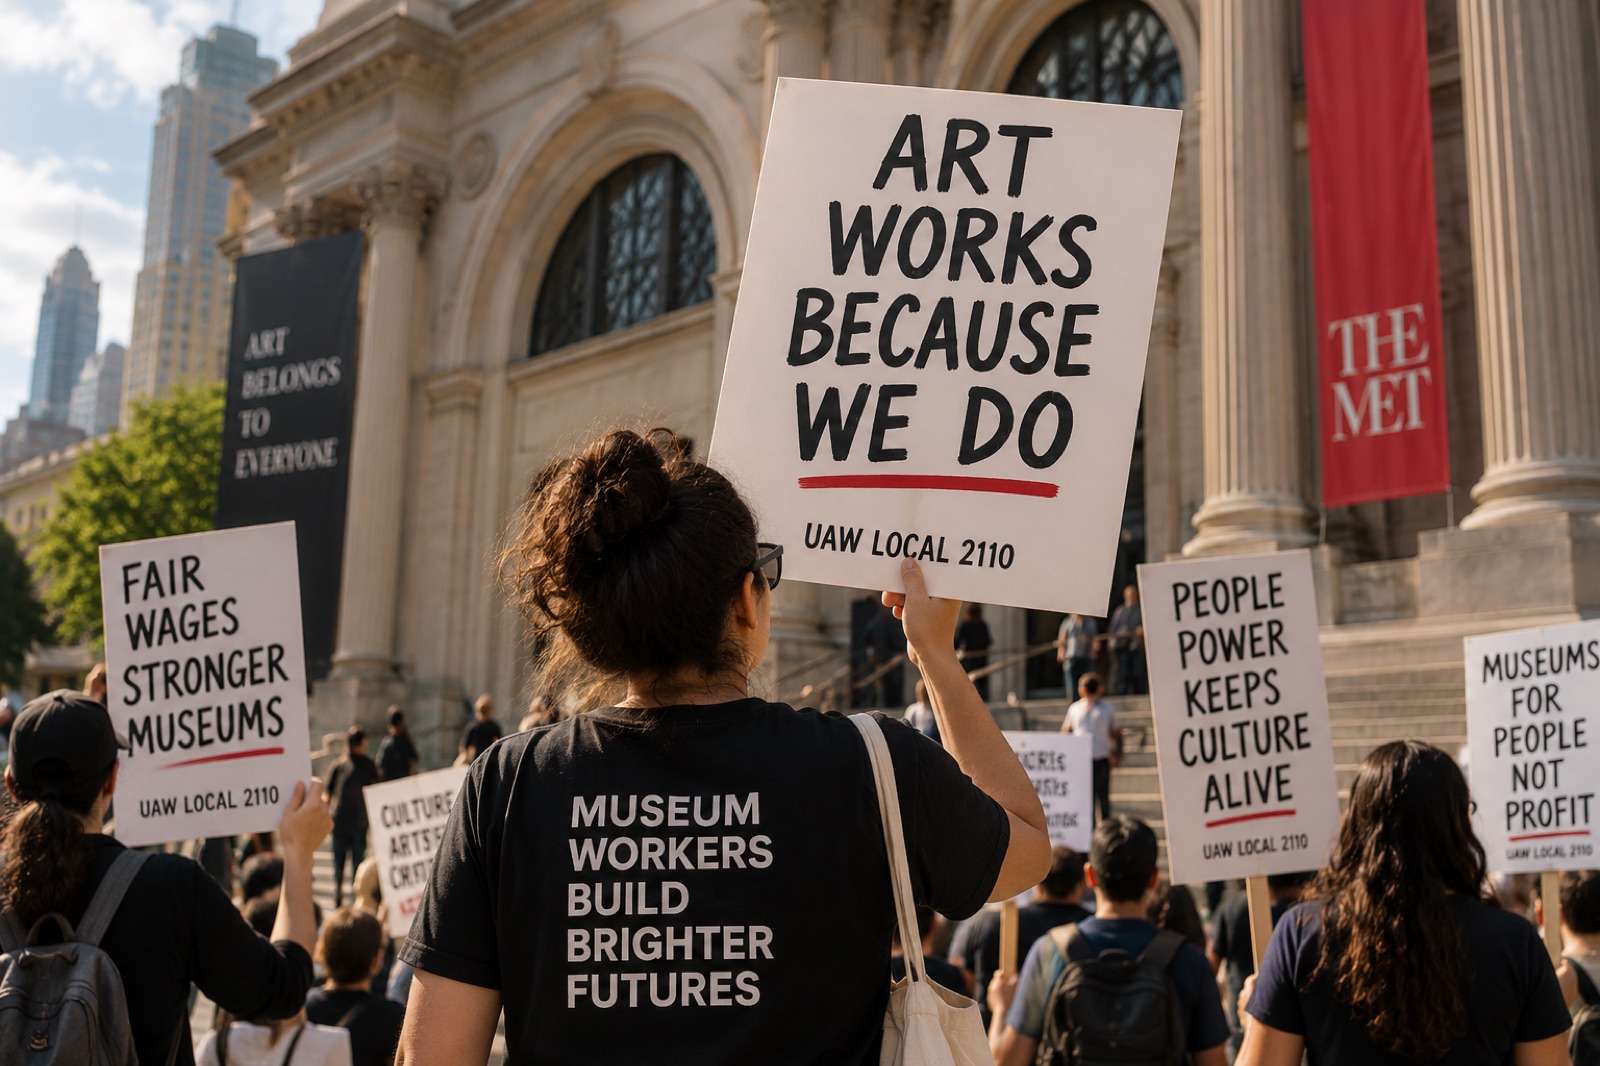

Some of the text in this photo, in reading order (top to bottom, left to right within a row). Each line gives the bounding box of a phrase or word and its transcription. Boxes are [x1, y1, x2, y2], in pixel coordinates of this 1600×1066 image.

[872, 114, 1053, 198] ART
[829, 201, 1097, 289] WORKS
[244, 326, 290, 361] ART
[786, 287, 1099, 377] BECAUSE
[1328, 303, 1430, 377] THE
[242, 355, 342, 399] BELONGS
[238, 407, 271, 438] TO
[796, 382, 1074, 469] WE DO
[1331, 366, 1432, 442] MET
[235, 437, 339, 478] EVERYONE
[804, 522, 1015, 569] UAW LOCAL 2110
[122, 555, 205, 604] FAIR
[1172, 572, 1285, 621] PEOPLE
[125, 597, 239, 651] WAGES
[1178, 619, 1289, 670] POWER
[123, 643, 289, 706] STRONGER
[1482, 640, 1600, 683] MUSEUMS
[1184, 668, 1280, 717] KEEPS
[1512, 683, 1562, 718] FOR
[128, 696, 284, 757] MUSEUMS
[1179, 712, 1312, 767] CULTURE
[1494, 718, 1587, 757] PEOPLE
[1204, 764, 1293, 813] ALIVE
[1512, 758, 1564, 793] NOT
[139, 785, 279, 818] UAW LOCAL 2110
[571, 791, 760, 828] MUSEUM
[1506, 793, 1595, 831] PROFIT
[568, 834, 773, 872] WORKERS
[1202, 833, 1309, 860] UAW LOCAL 2110
[1505, 843, 1593, 861] UAW LOCAL 2110
[567, 881, 690, 917] BUILD
[567, 925, 774, 962] BRIGHTER
[567, 970, 761, 1008] FUTURES
